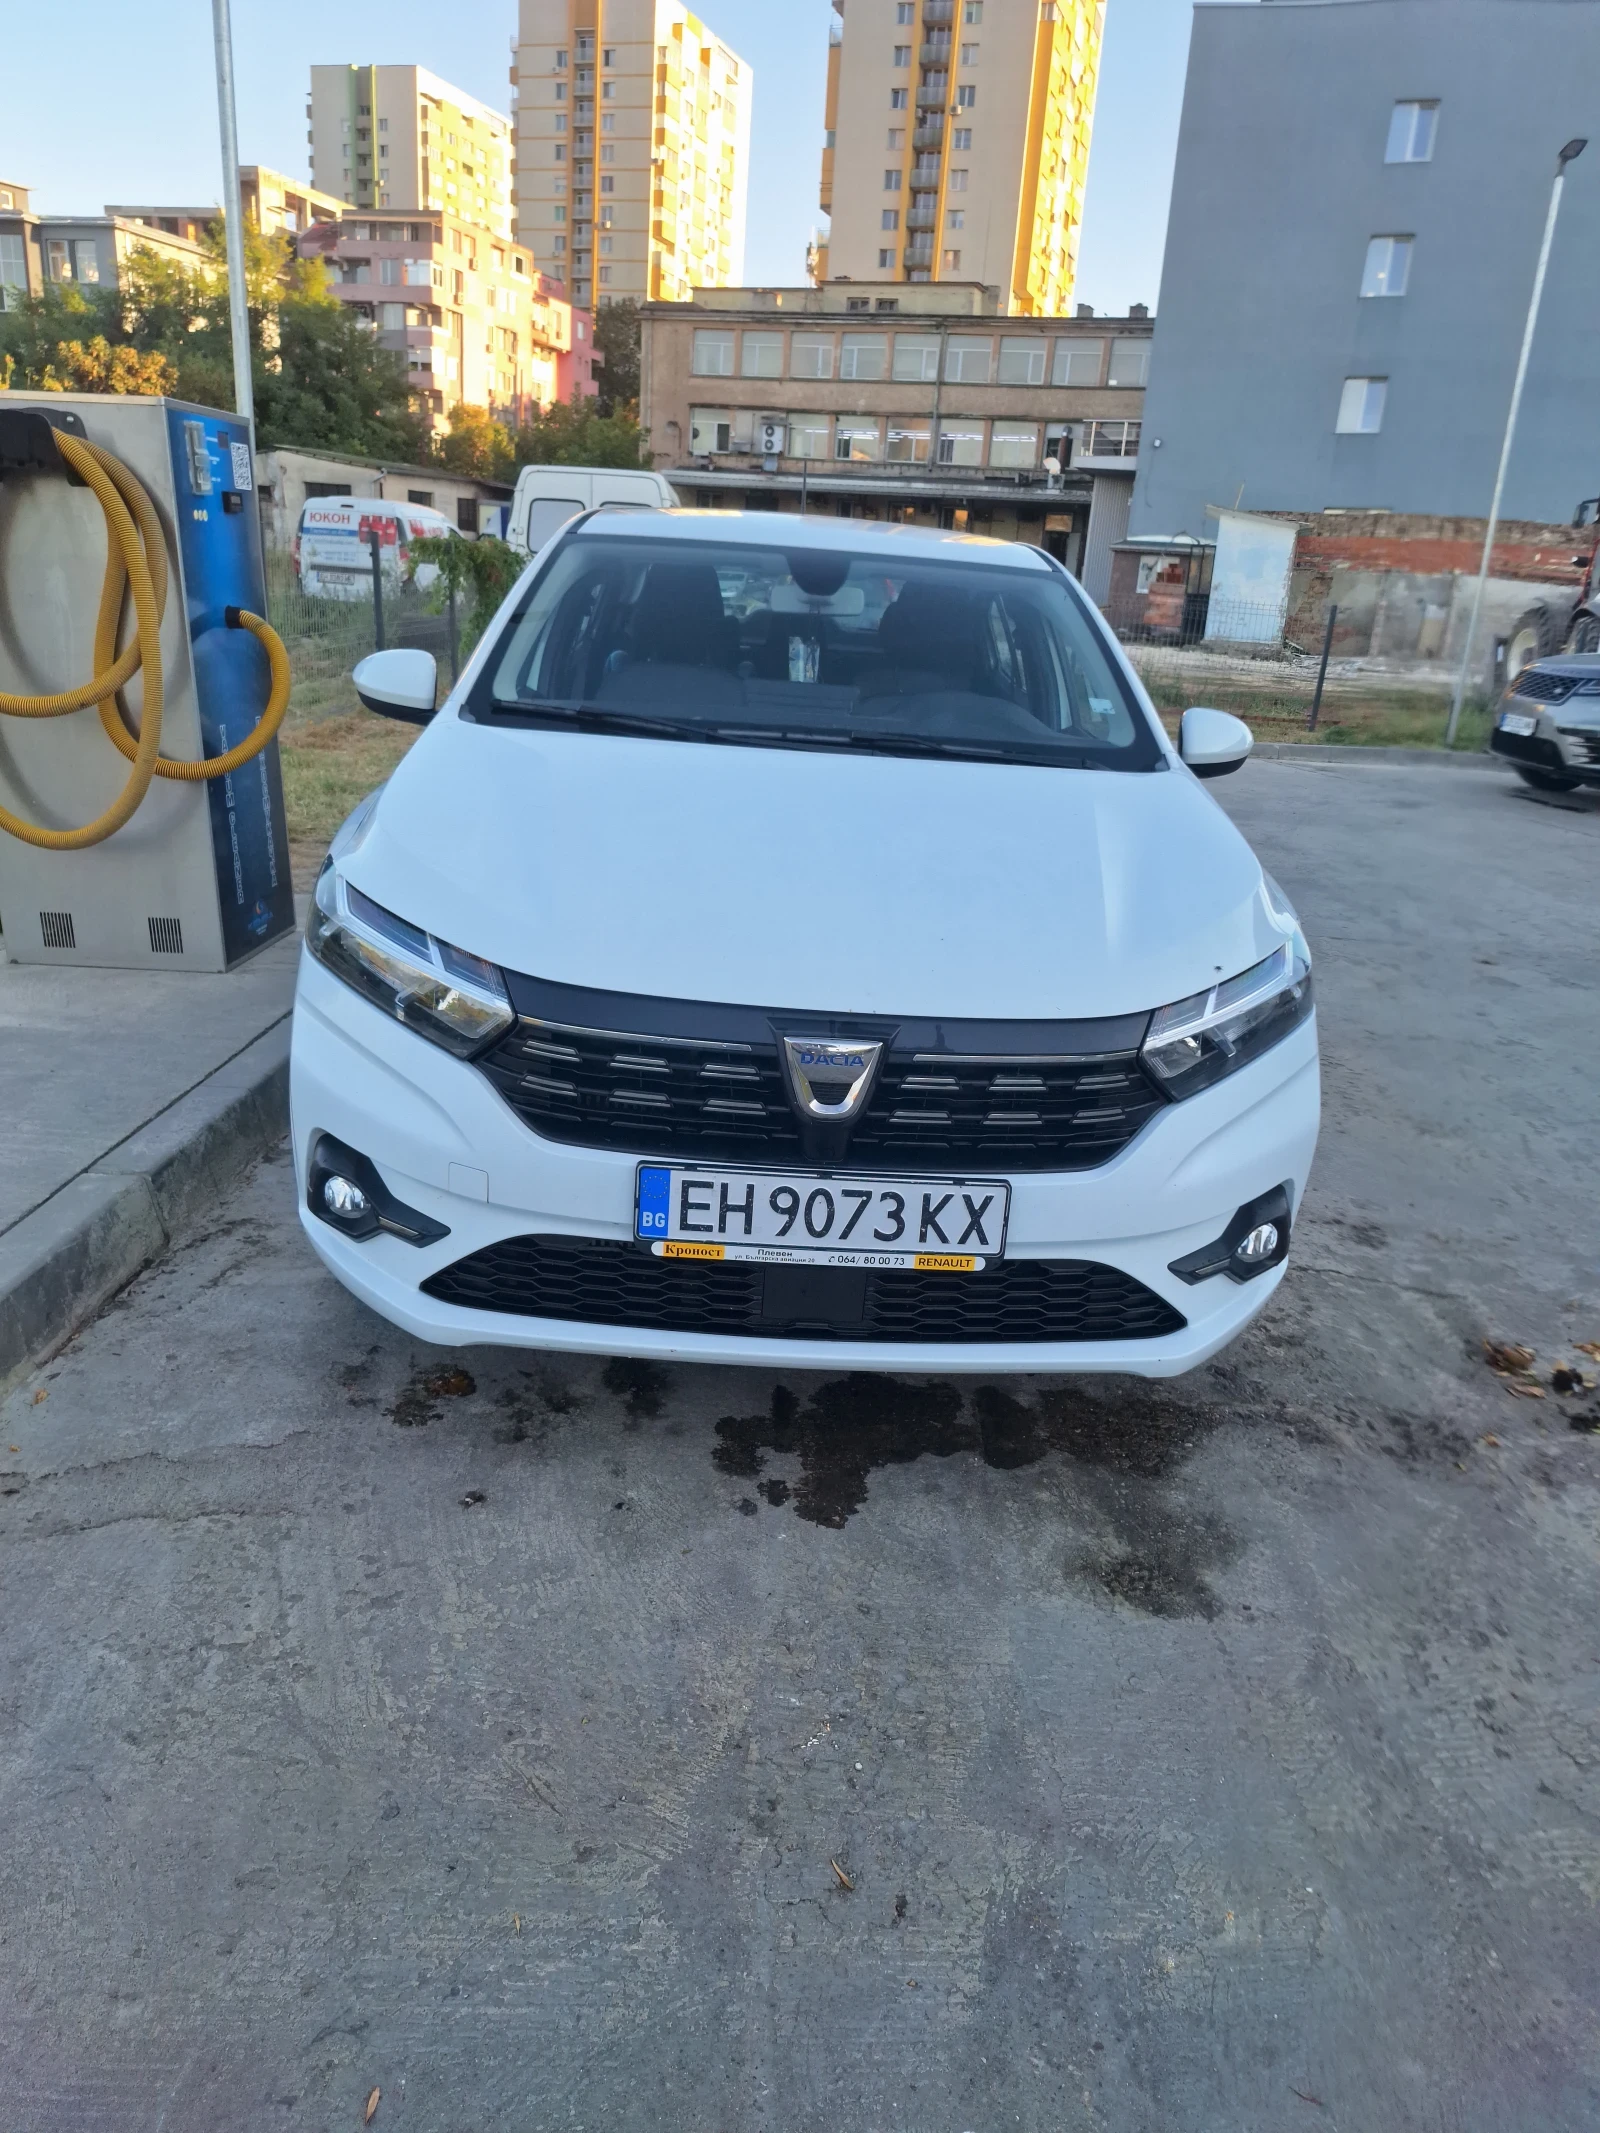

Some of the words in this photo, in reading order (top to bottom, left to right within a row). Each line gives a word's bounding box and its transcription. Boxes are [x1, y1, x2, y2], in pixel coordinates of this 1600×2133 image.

[309, 512, 350, 524] ЮКОН
[220, 724, 235, 808] VAUUM
[228, 811, 245, 904] CLEANER
[801, 1052, 864, 1067] DACIA
[679, 1179, 755, 1235] EH
[769, 1185, 906, 1241] 9073
[918, 1192, 994, 1246] KX
[642, 1211, 666, 1228] BG
[665, 1244, 723, 1257] Кроност
[757, 1248, 793, 1257] Плевен
[837, 1255, 861, 1264] 064/
[863, 1256, 876, 1264] 80
[878, 1256, 891, 1265] 00
[894, 1257, 905, 1265] 73
[918, 1257, 972, 1268] RENAULT
